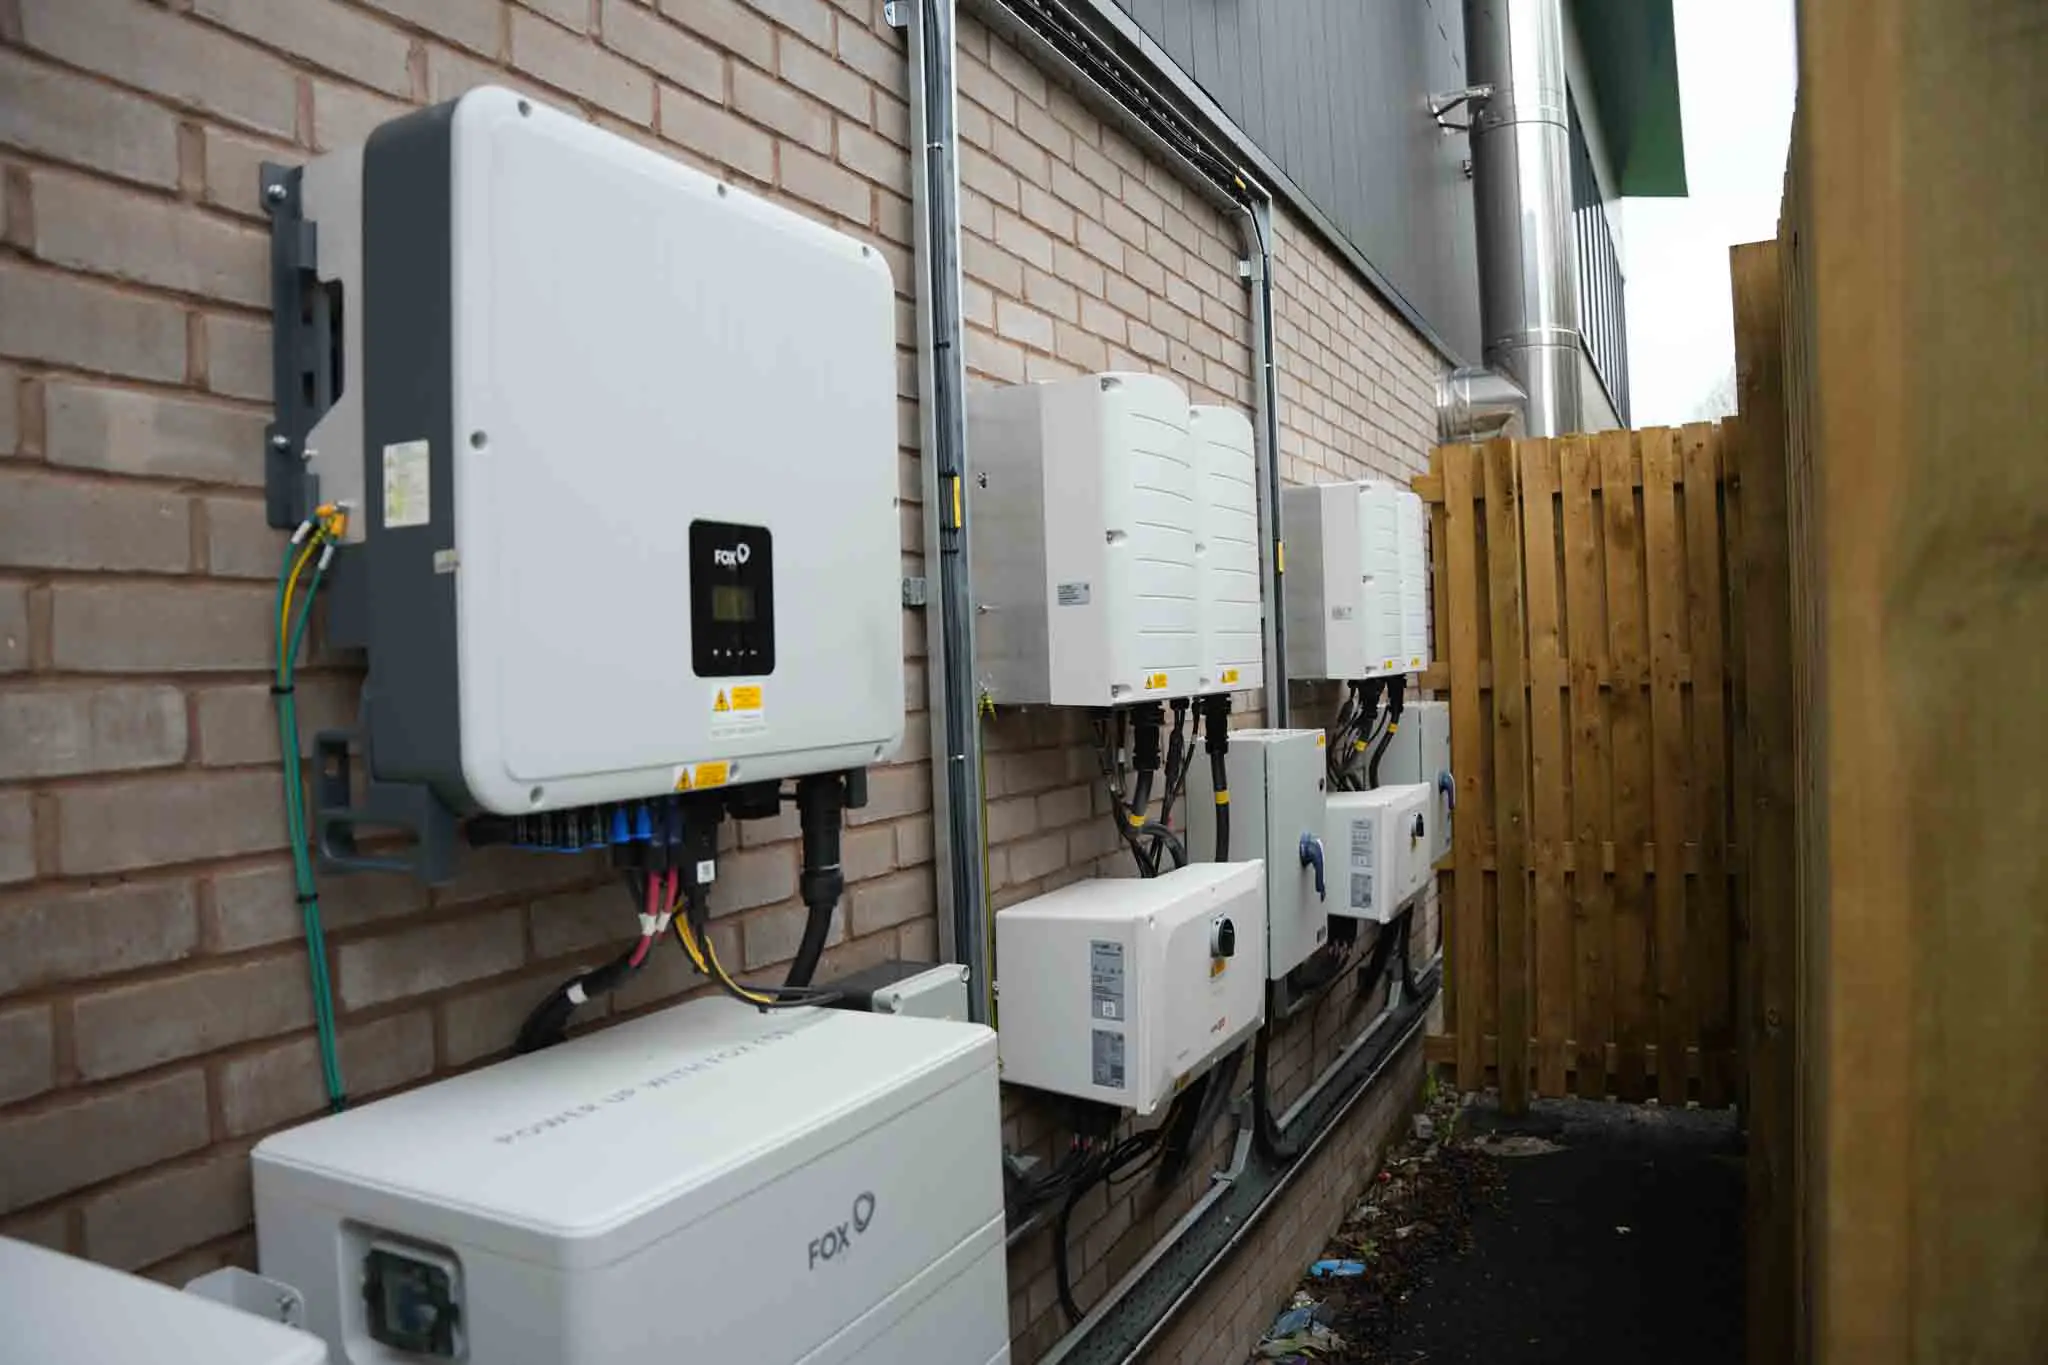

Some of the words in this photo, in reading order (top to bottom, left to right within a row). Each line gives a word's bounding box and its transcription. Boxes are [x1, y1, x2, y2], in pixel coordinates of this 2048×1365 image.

[714, 549, 737, 566] FOX
[493, 1103, 602, 1145] POWER
[601, 1088, 637, 1104] UP
[639, 1061, 708, 1089] WITH
[808, 1221, 850, 1271] FOX
